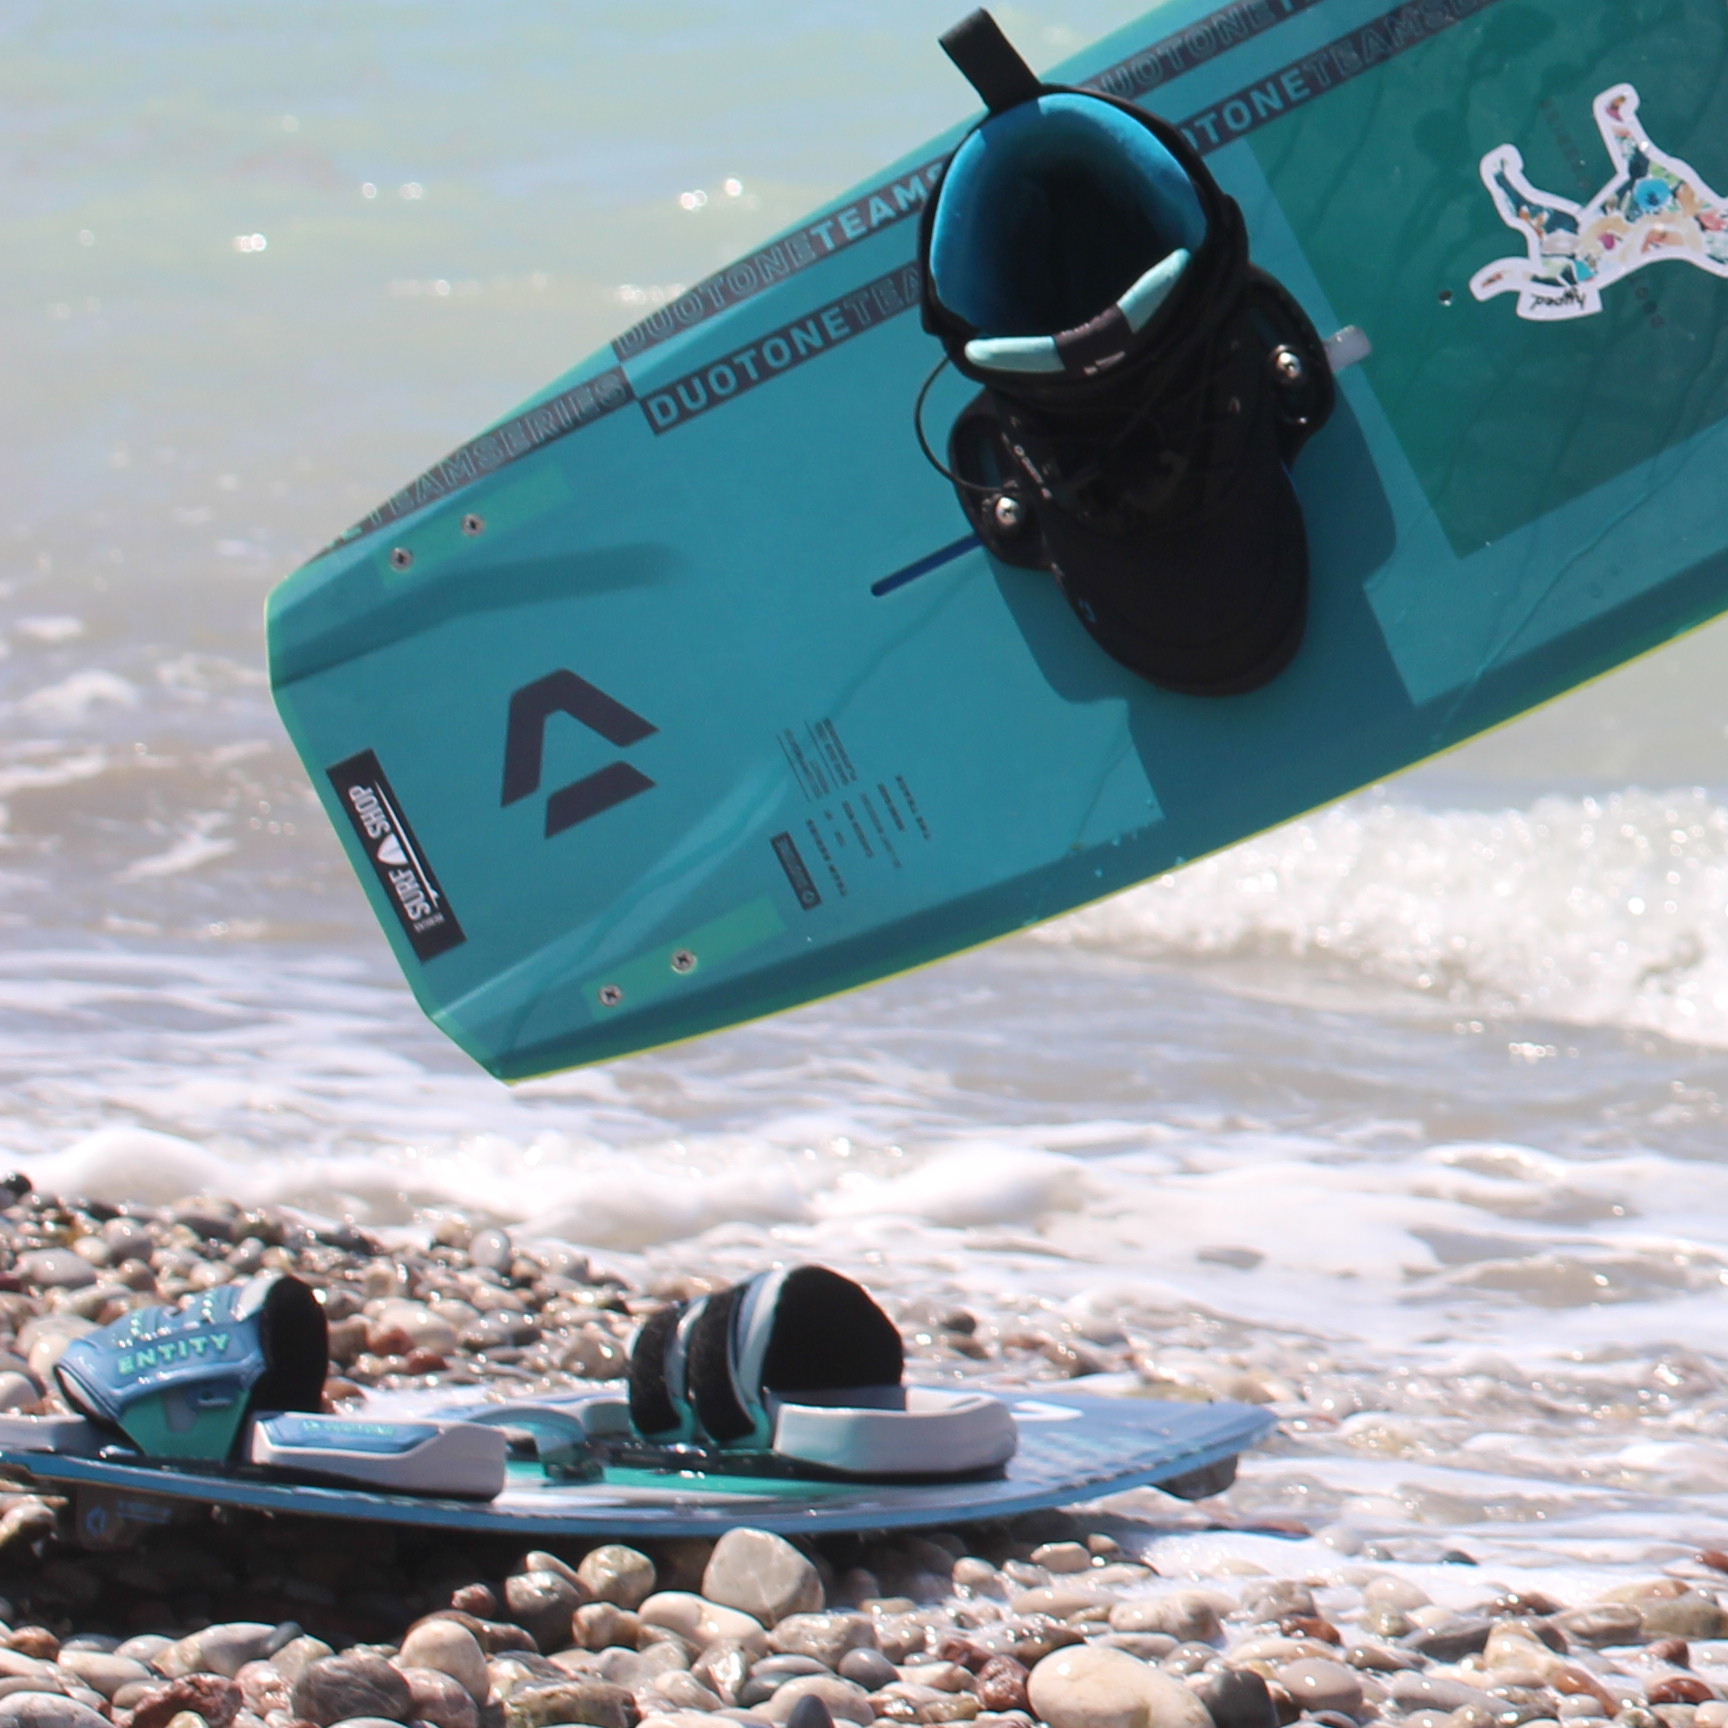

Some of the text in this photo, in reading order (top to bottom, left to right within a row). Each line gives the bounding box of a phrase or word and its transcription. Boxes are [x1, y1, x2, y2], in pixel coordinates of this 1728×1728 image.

[647, 306, 850, 428] DUOTONE
[348, 784, 390, 839] SHOP
[388, 868, 431, 921] SURF
[117, 1333, 230, 1374] ENTITY
